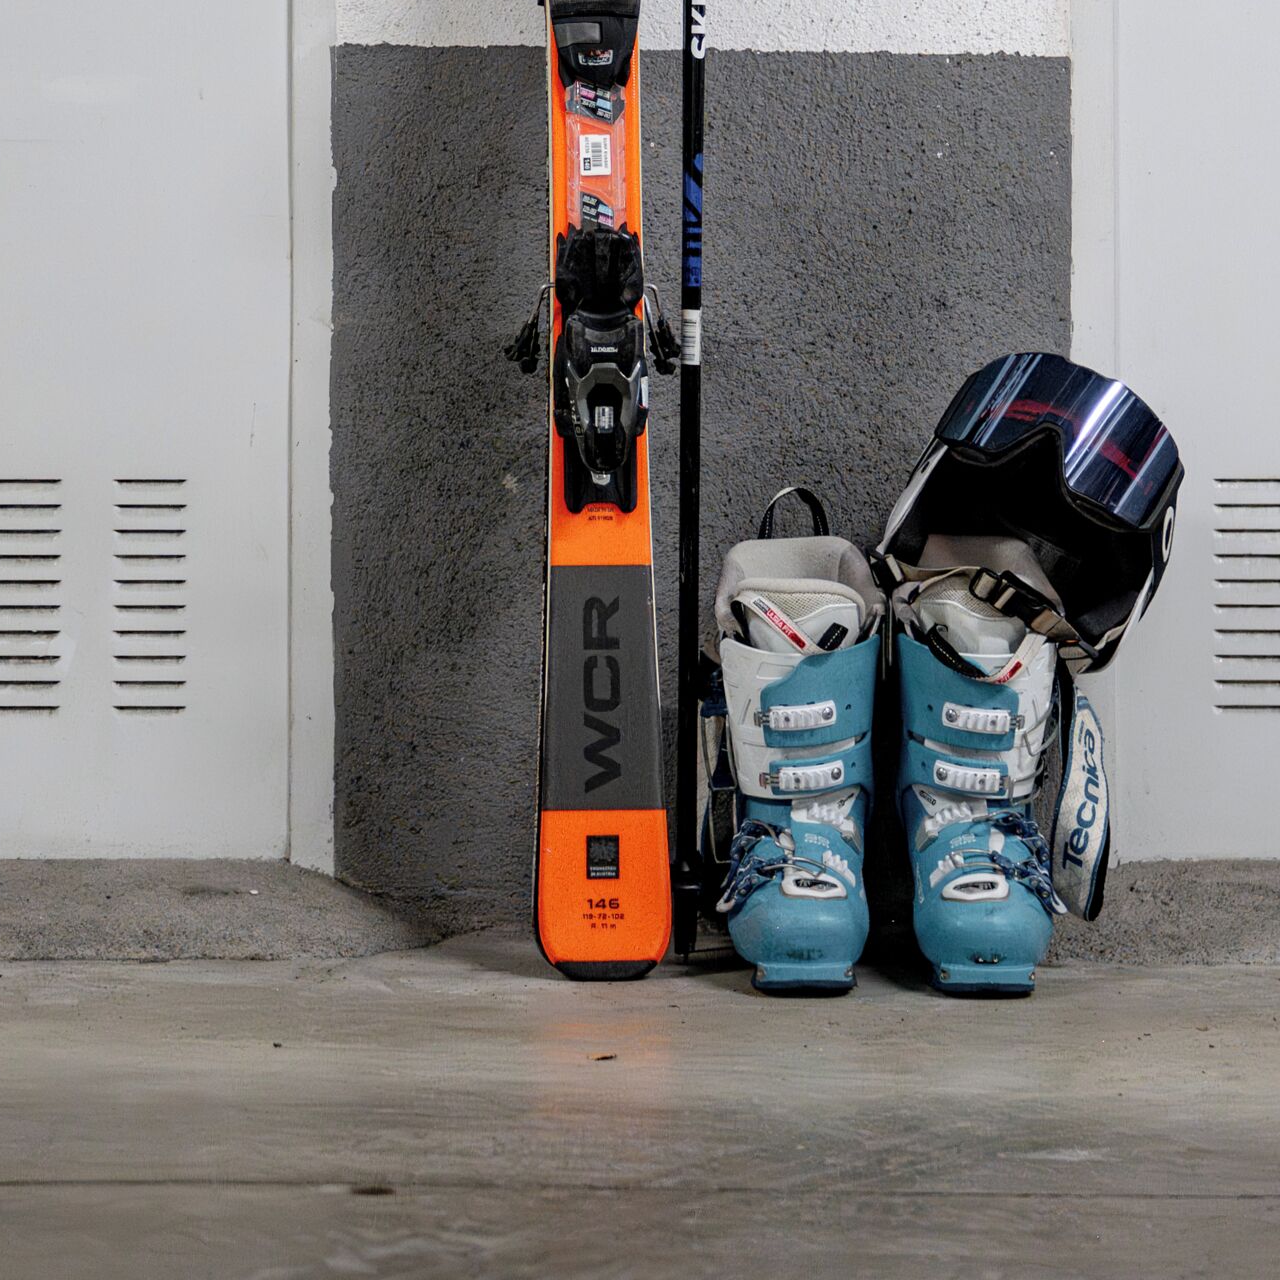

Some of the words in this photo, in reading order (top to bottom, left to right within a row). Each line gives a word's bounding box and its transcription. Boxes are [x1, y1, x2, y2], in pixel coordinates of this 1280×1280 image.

[582, 594, 621, 794] WCR
[1062, 727, 1100, 870] Tecnica
[587, 898, 620, 910] 146
